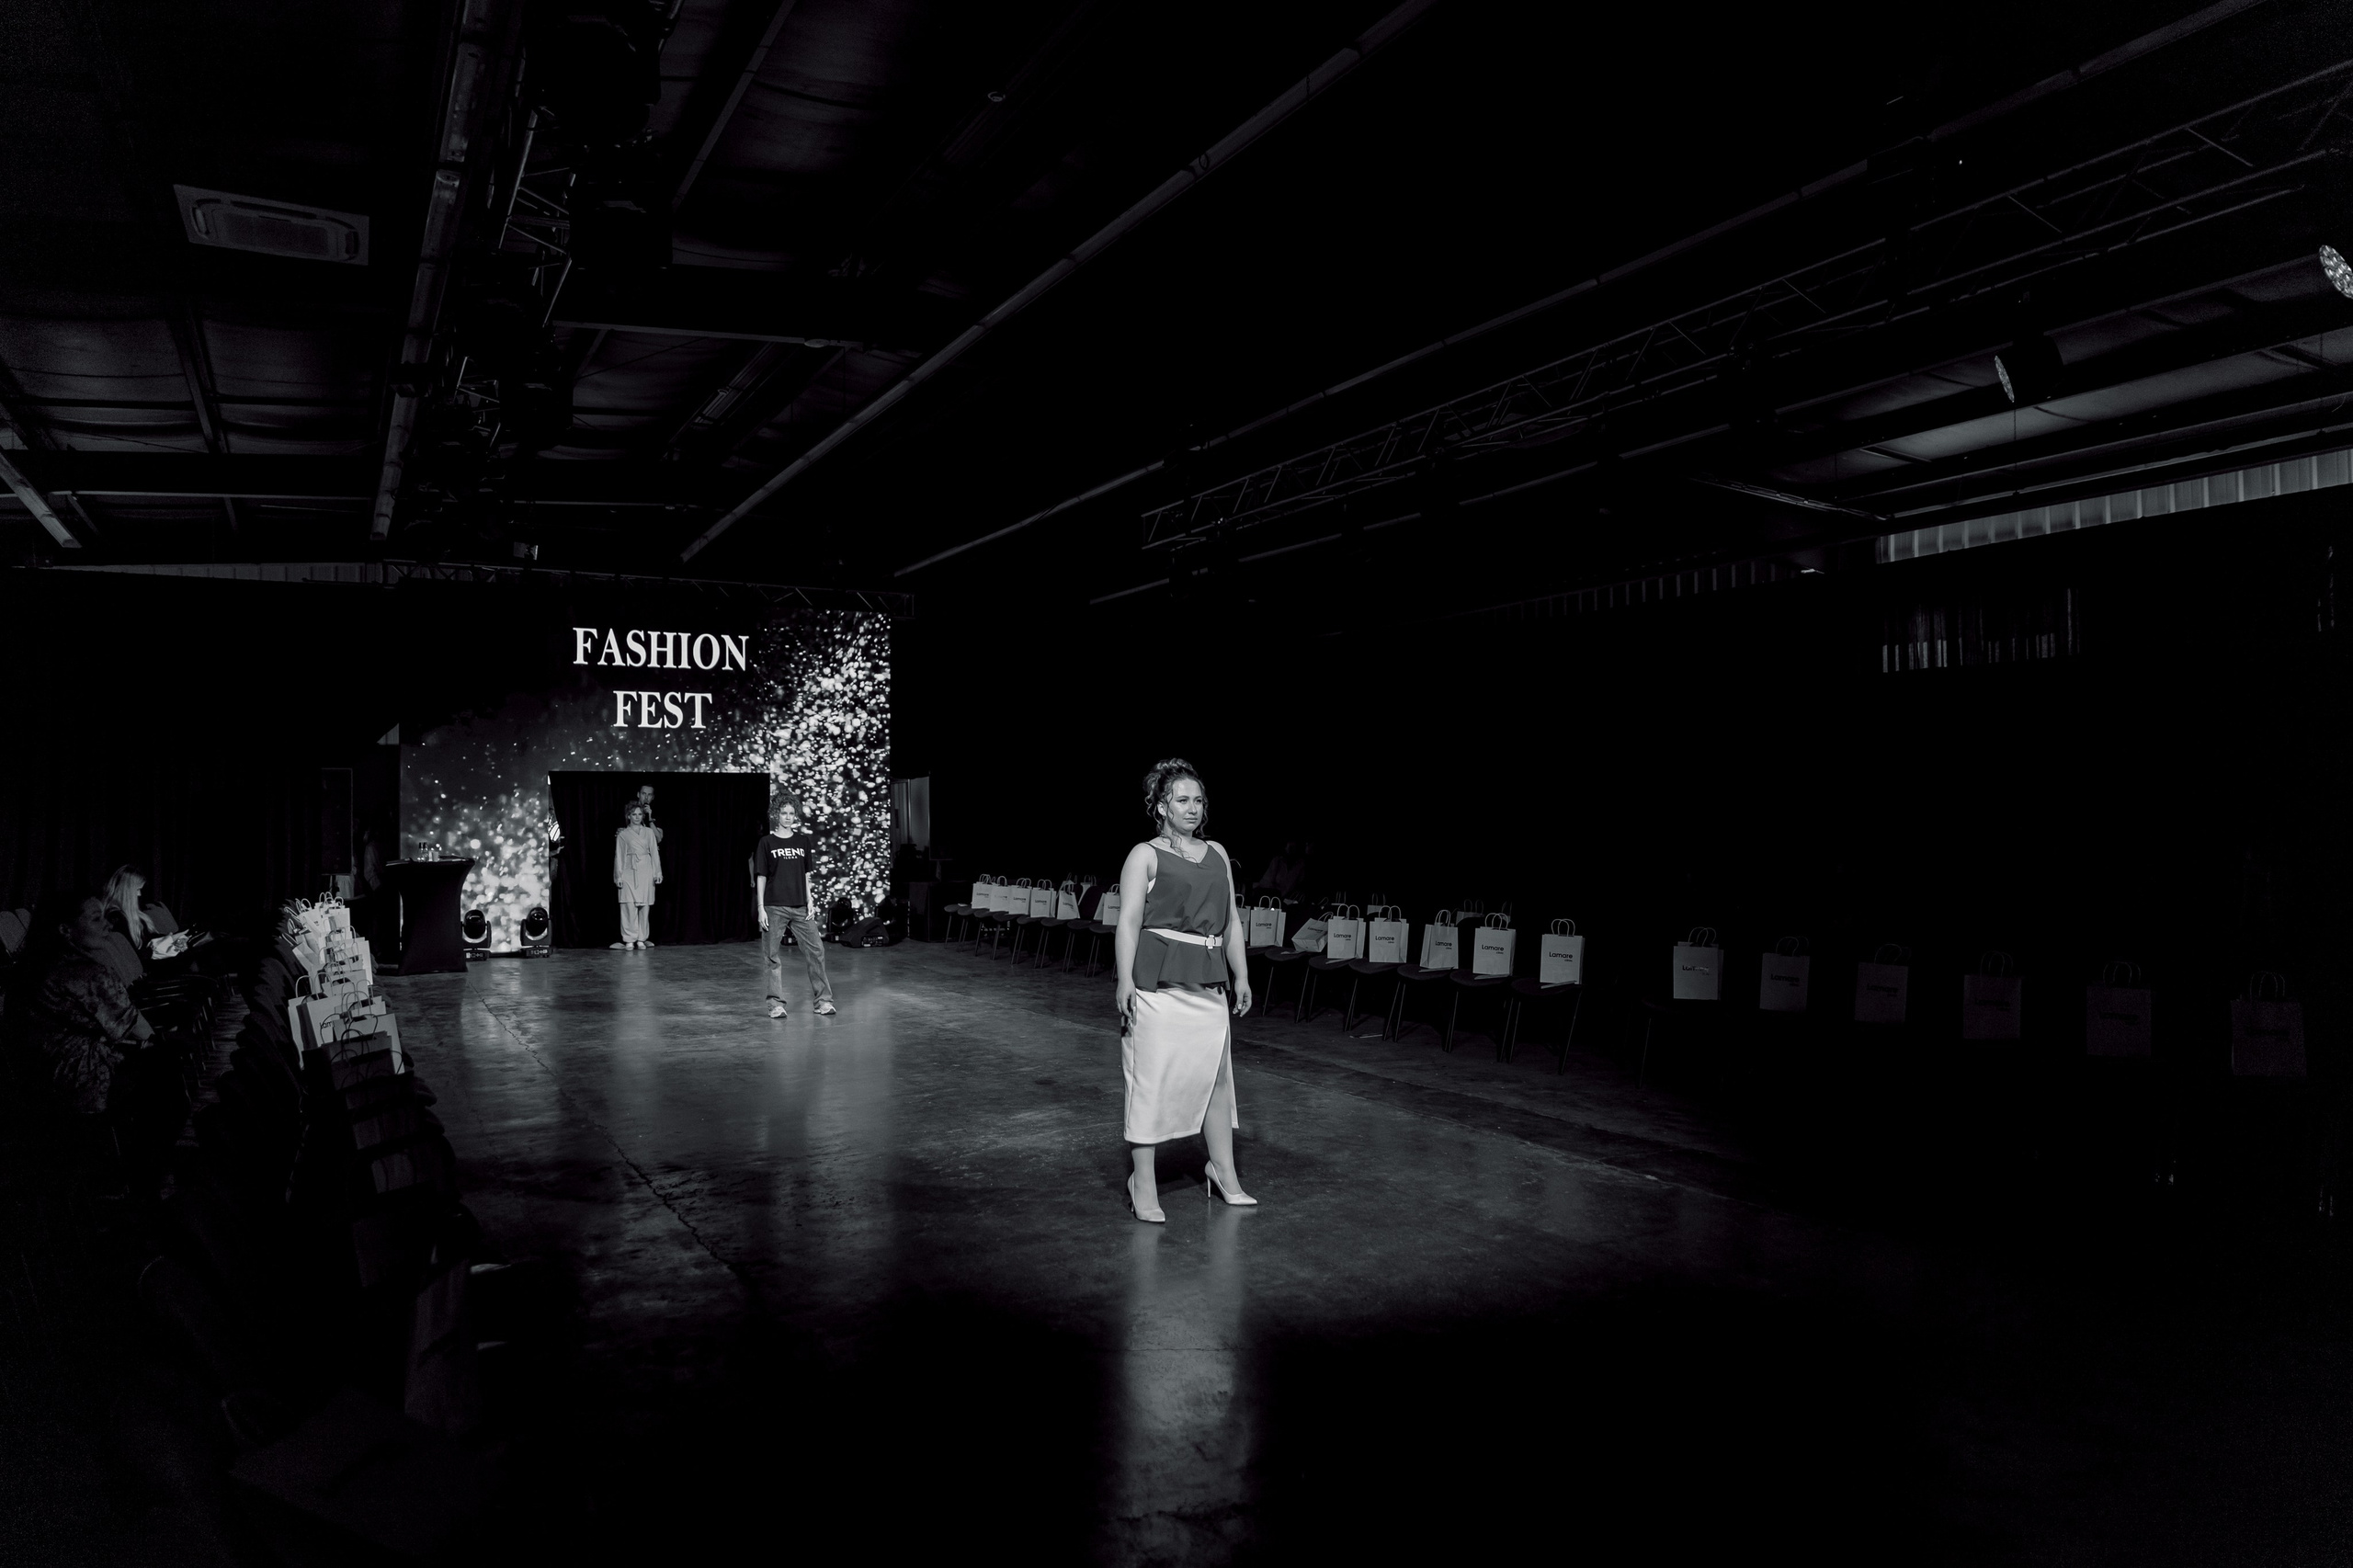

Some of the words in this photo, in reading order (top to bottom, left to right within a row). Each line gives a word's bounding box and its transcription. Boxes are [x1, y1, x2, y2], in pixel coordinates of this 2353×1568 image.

[572, 626, 750, 672] FASHION
[612, 690, 712, 729] FEST
[770, 847, 805, 858] TREND
